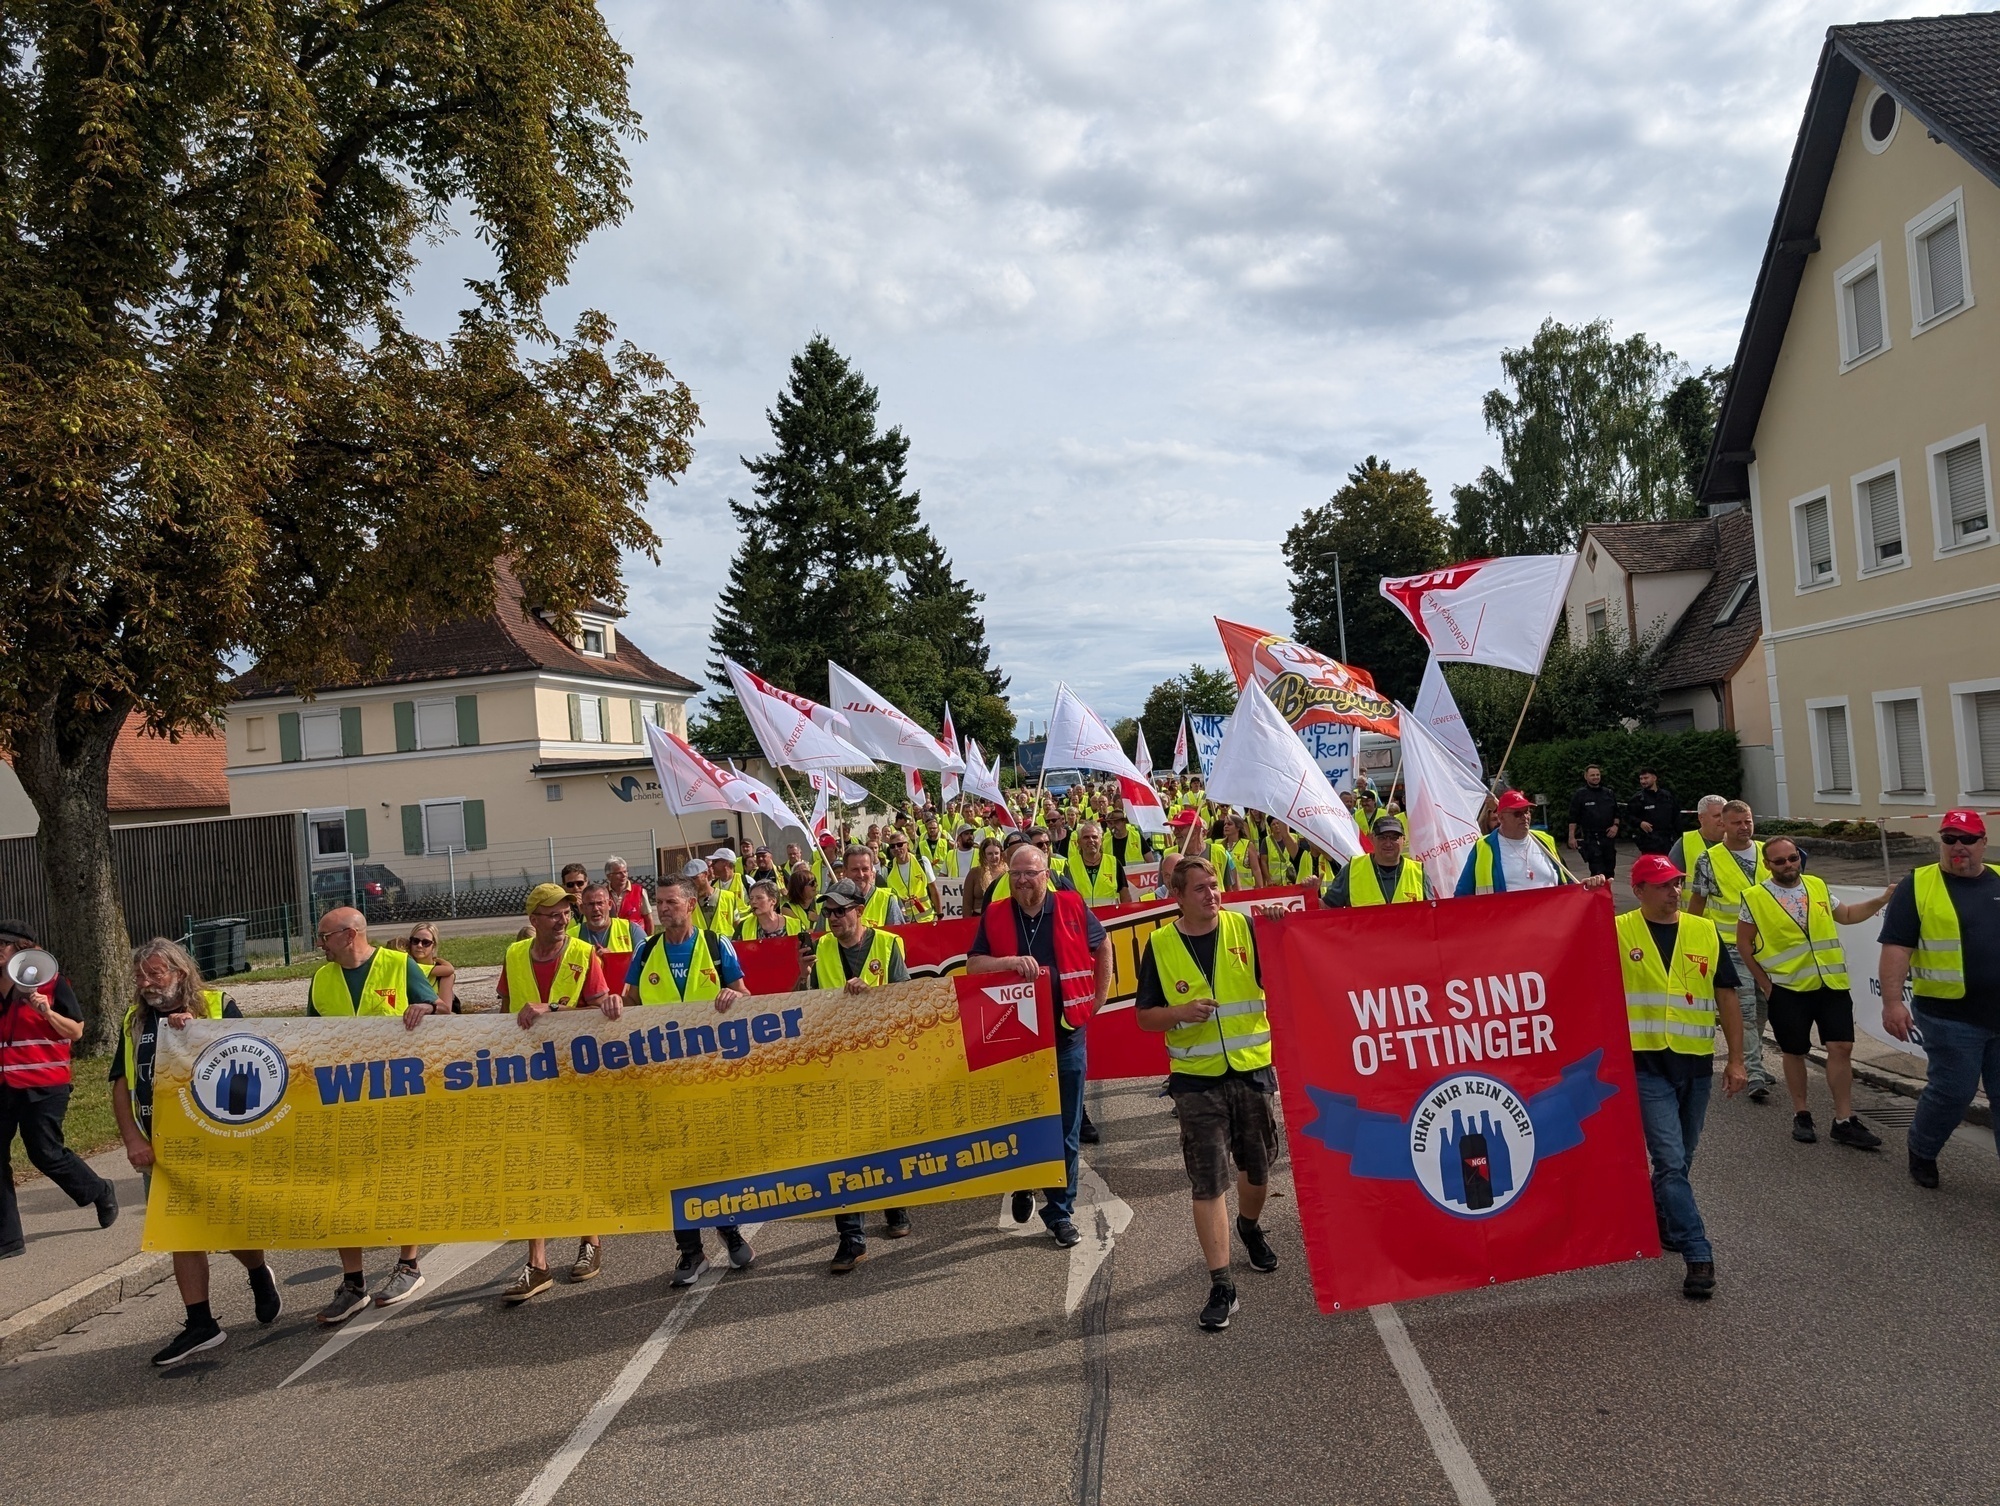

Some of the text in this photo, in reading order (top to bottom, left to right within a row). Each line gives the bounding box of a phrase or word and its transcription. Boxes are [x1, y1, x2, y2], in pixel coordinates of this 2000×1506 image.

[1692, 955, 1708, 964] NGG
[999, 985, 1034, 1002] NGG
[1347, 971, 1547, 1031] WIR SIND
[986, 1004, 1016, 1041] GEWERKSCHAFT
[202, 1044, 279, 1081] OHNE WIR KEIN BIER!
[314, 1006, 804, 1106] WIR sind Oettinger
[177, 1086, 293, 1139] Oettinger Brauerei Tarifrunde 2025
[1413, 1081, 1533, 1153] OHNE WIR KEIN BIER!
[683, 1133, 1020, 1222] Getränke. Fair. Für alle!
[1471, 1157, 1487, 1166] NGG
